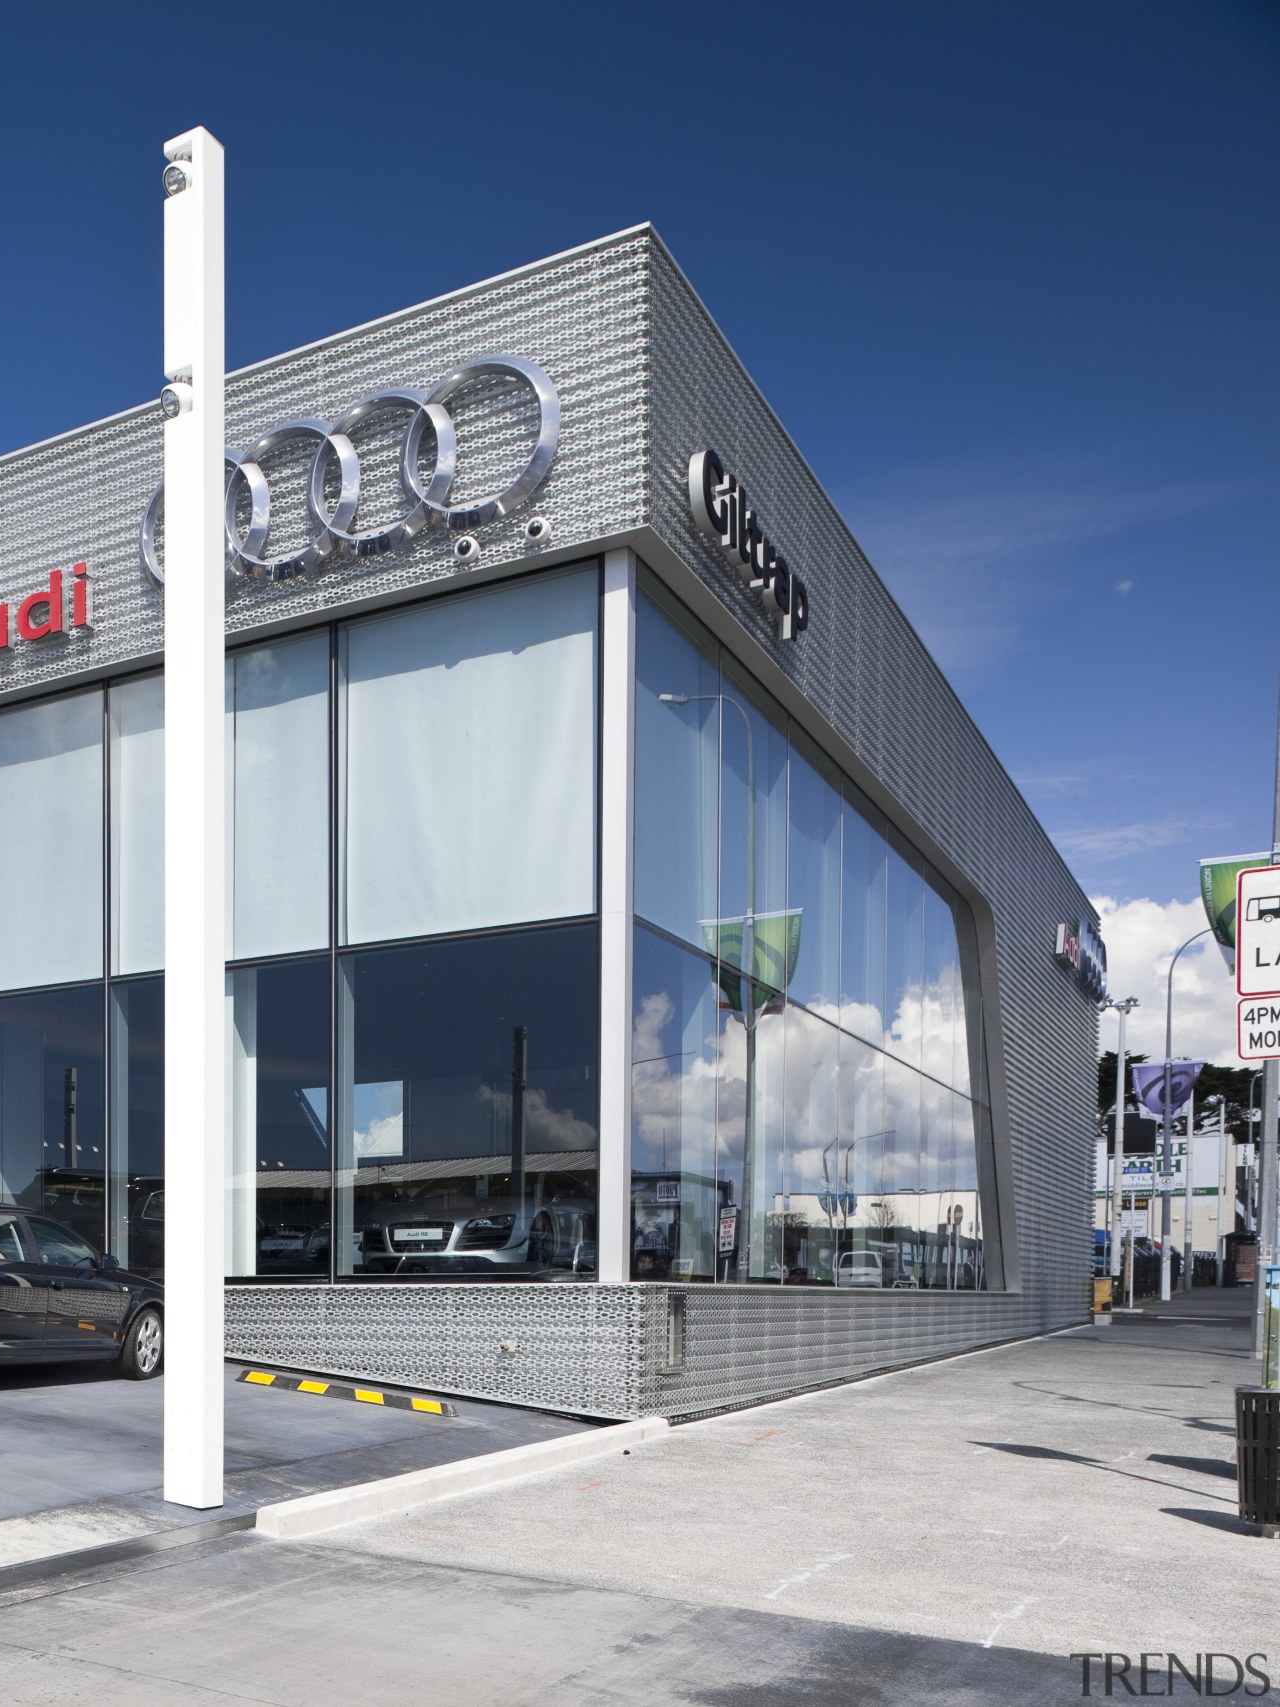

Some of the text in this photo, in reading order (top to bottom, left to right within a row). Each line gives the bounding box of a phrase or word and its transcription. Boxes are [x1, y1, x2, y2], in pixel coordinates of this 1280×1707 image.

[688, 448, 809, 642] Giltrap
[1203, 867, 1213, 892] UNION
[1243, 1006, 1280, 1025] 4PM
[1249, 1030, 1280, 1050] MO
